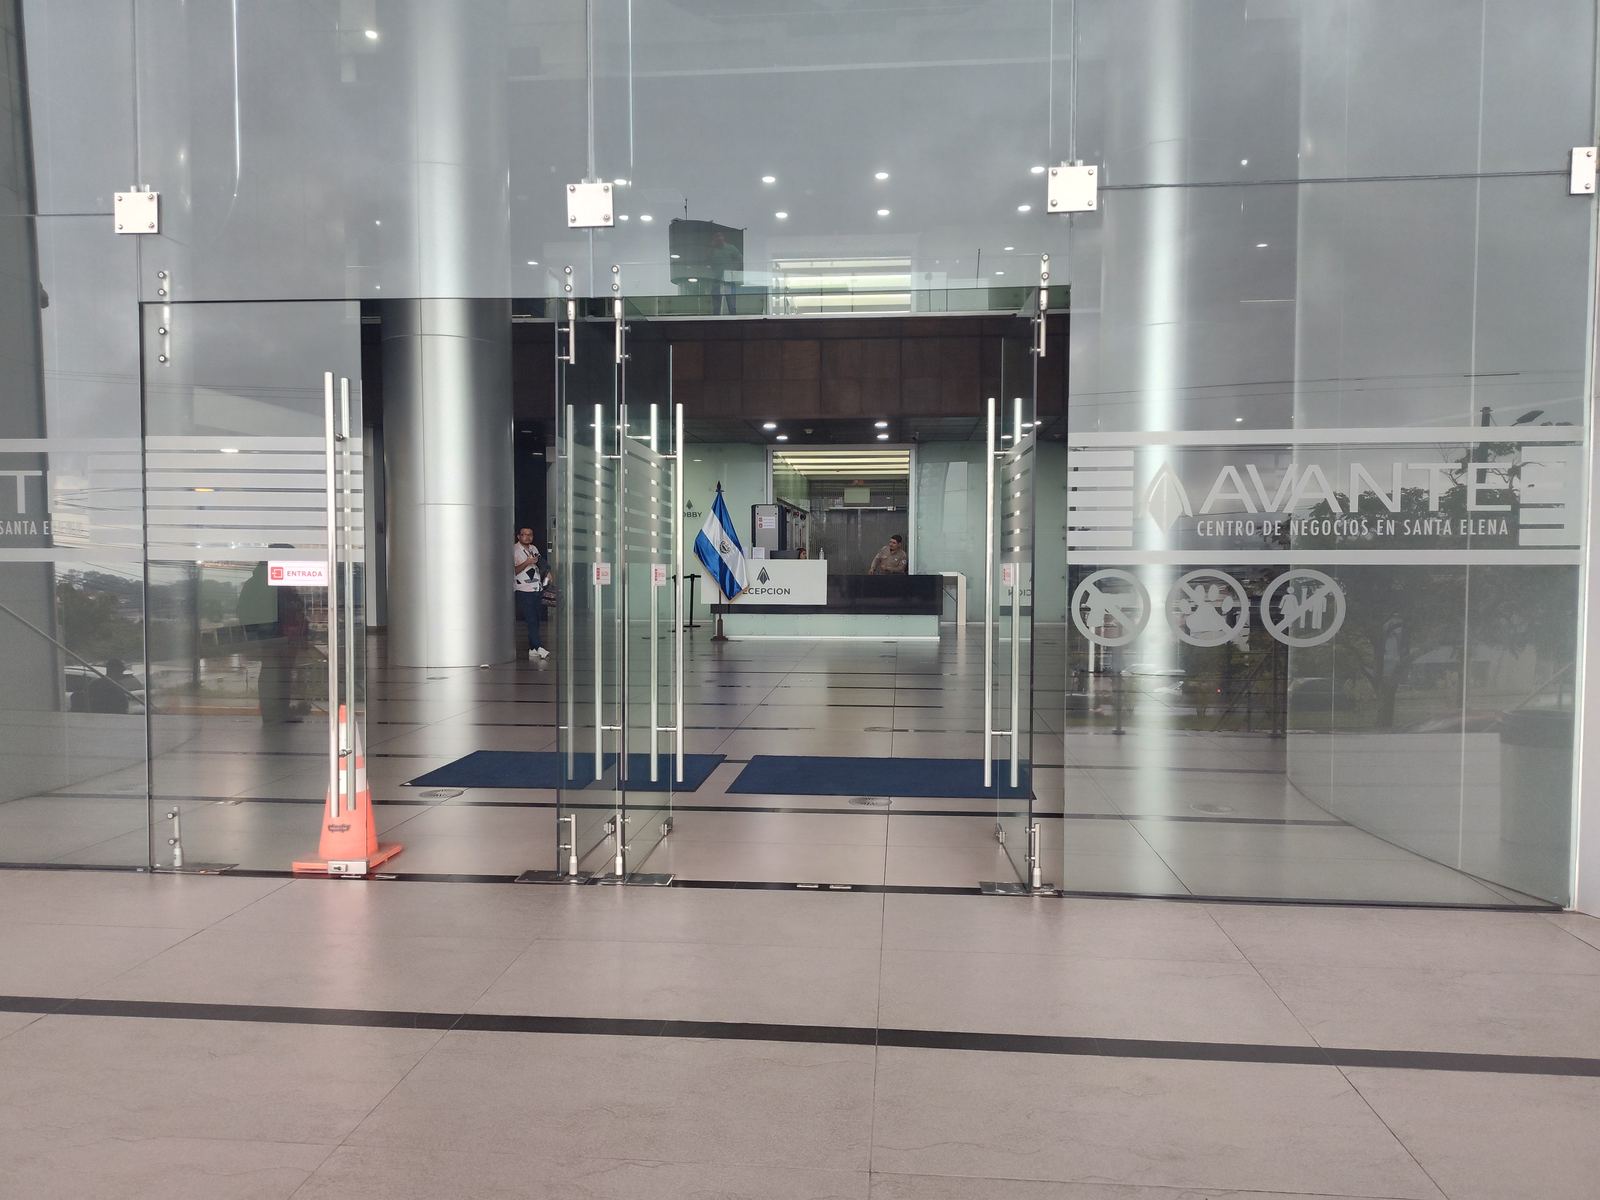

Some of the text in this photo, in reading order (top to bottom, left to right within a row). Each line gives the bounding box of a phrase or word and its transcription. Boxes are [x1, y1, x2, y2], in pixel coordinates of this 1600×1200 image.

[1198, 462, 1513, 514] AVANTE
[1197, 519, 1508, 537] CENTRO DE NEGOCIOS EN SANTA ELENA
